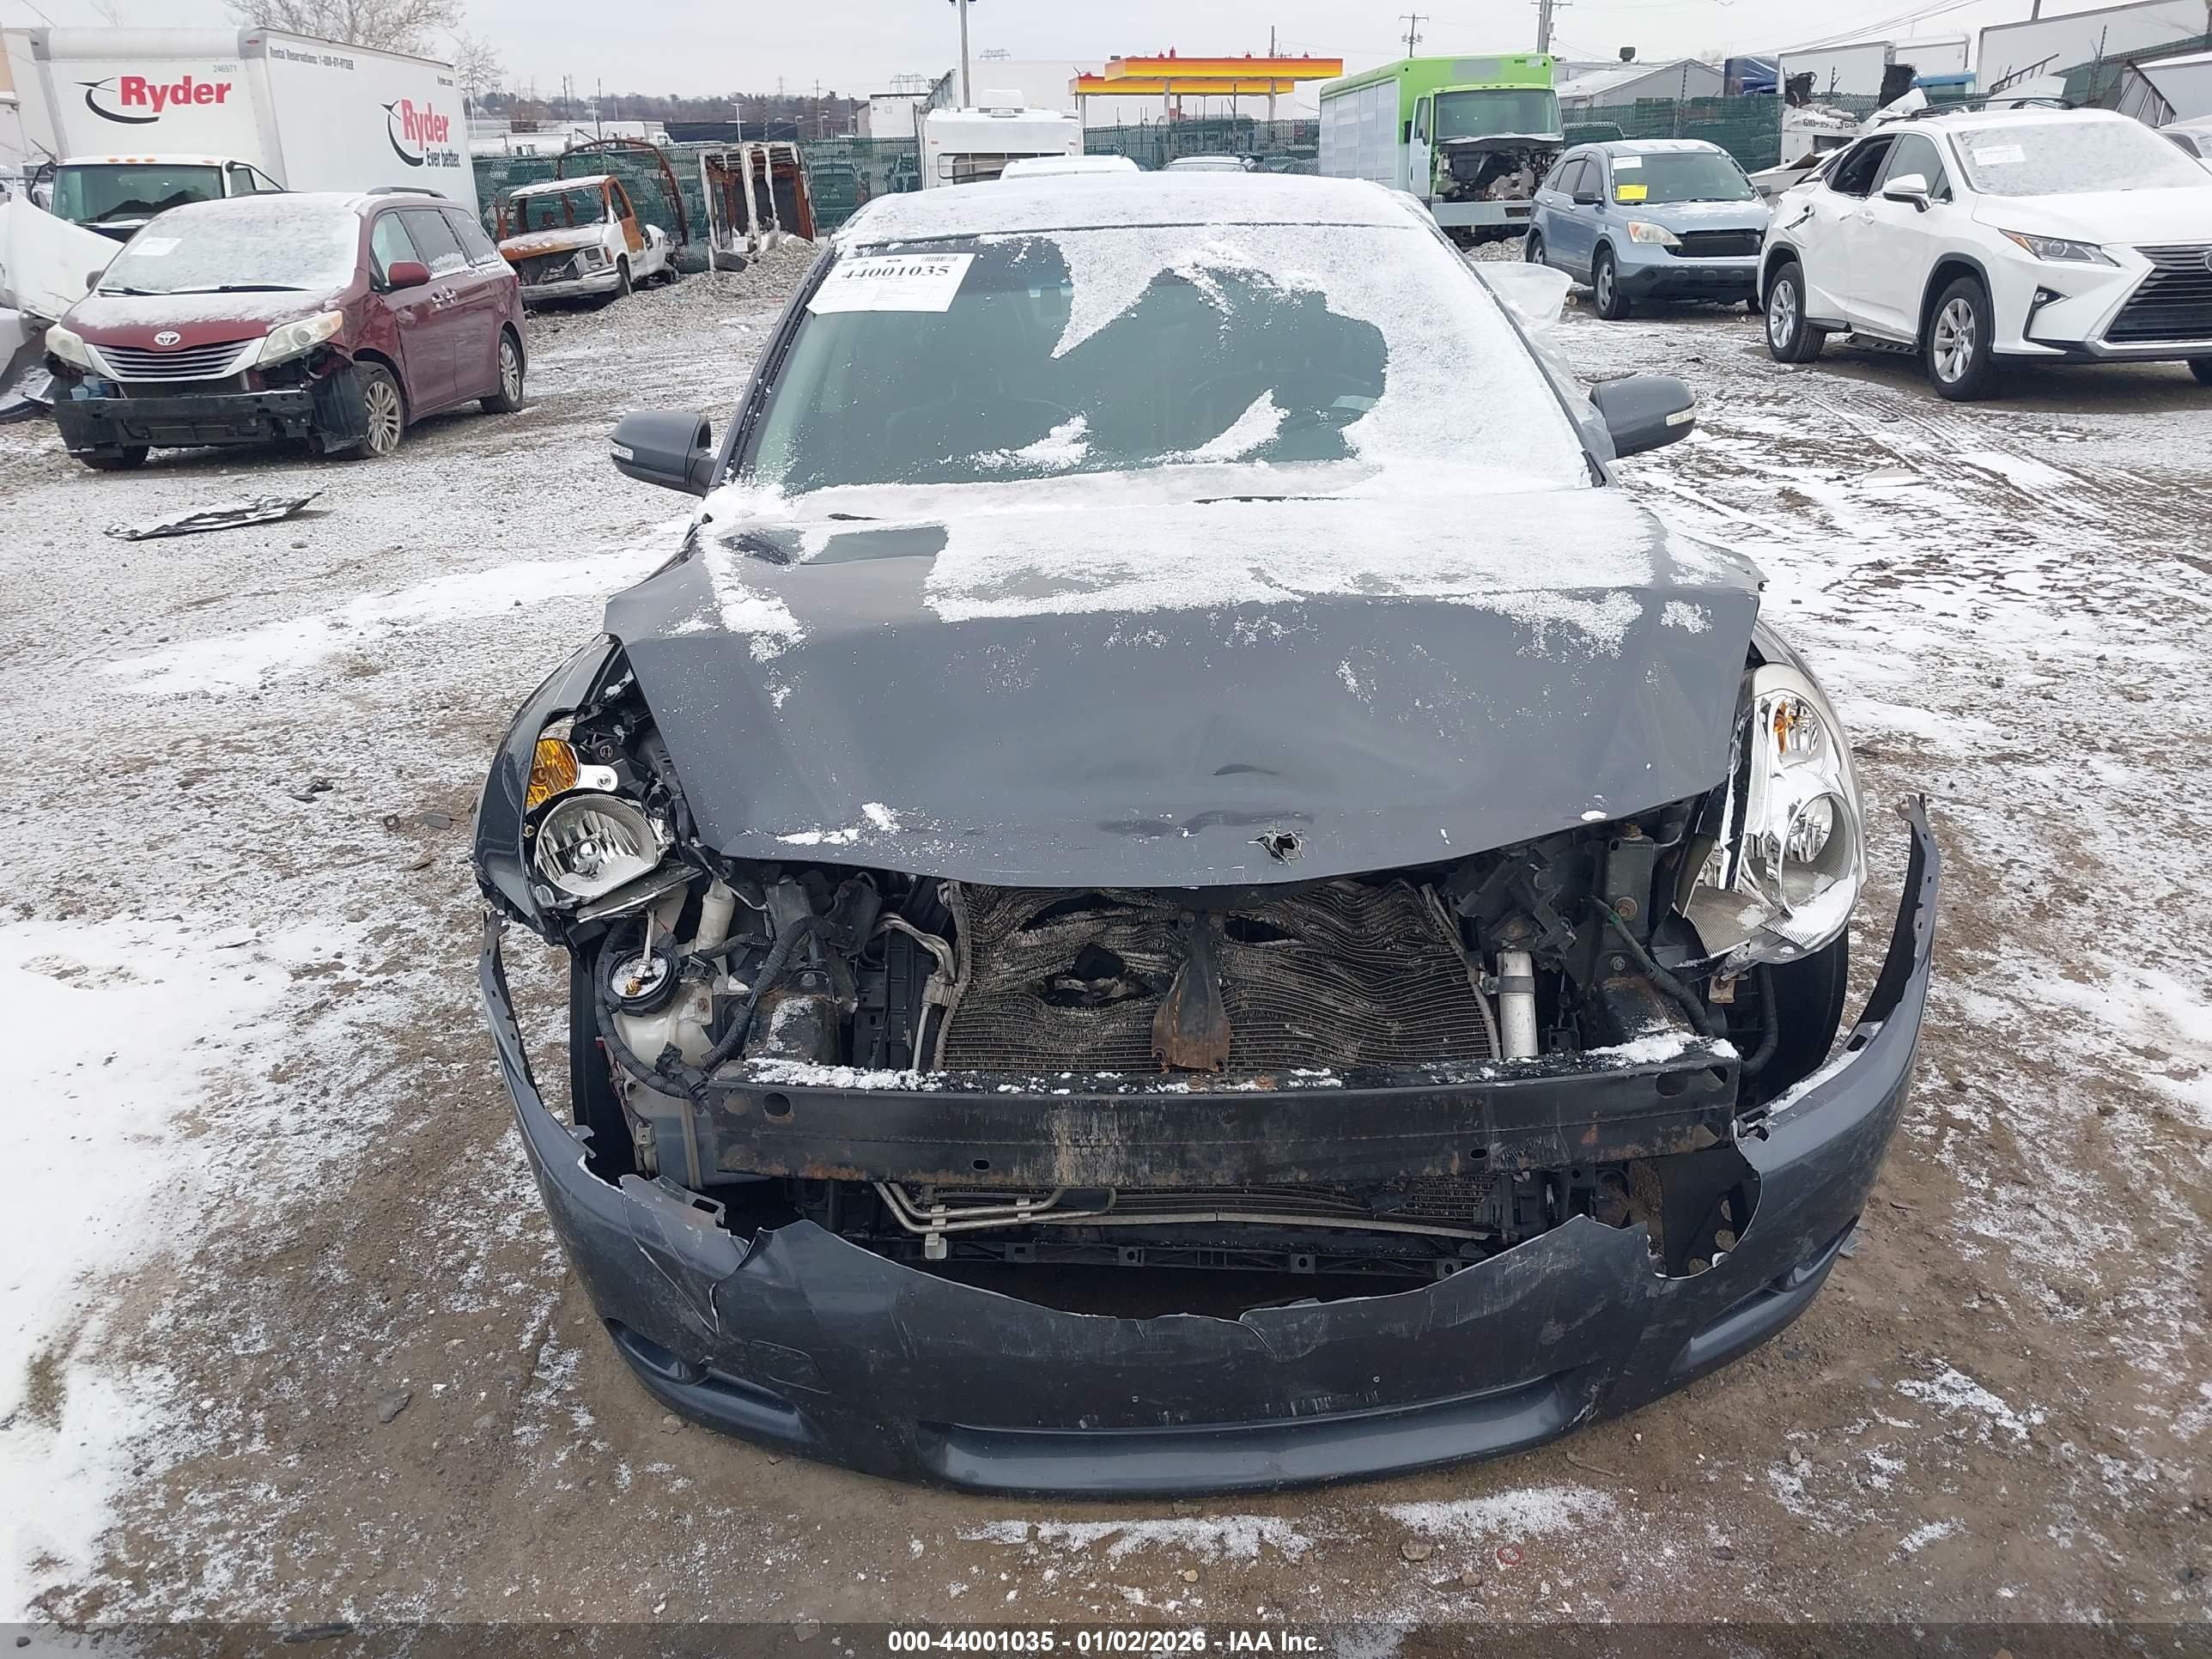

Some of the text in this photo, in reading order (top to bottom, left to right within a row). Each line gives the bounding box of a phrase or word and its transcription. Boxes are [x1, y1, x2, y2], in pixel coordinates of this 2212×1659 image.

[121, 76, 232, 112] Ryder
[401, 99, 449, 151] Ryder
[426, 147, 461, 168] Ever better.
[842, 266, 951, 278] 44001035
